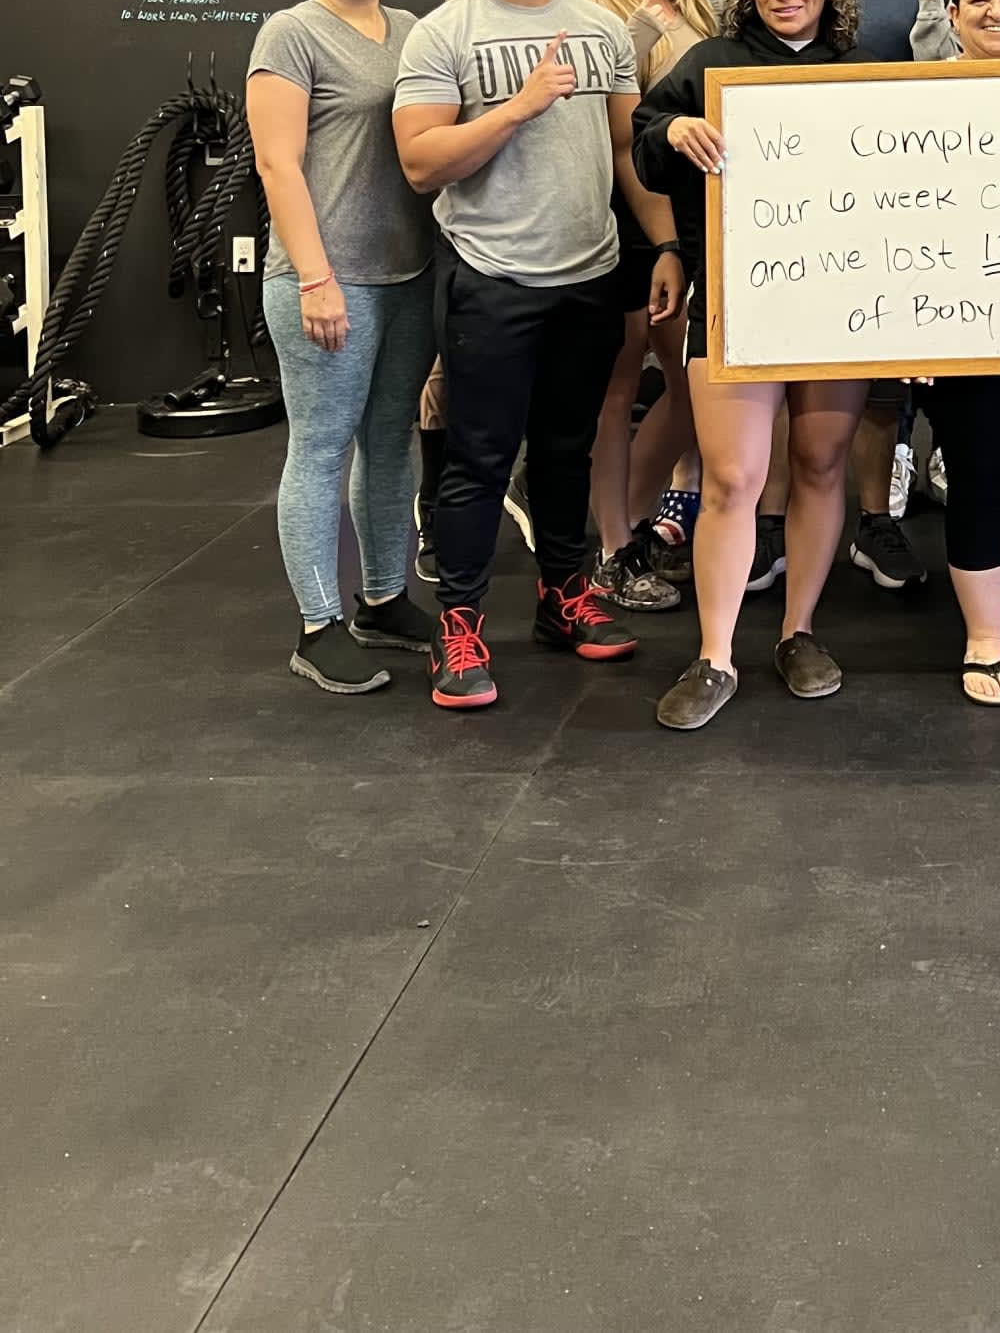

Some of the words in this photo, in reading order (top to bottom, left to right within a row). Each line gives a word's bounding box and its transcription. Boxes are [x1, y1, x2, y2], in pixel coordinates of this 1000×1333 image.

[137, 11, 165, 21] WORK
[753, 122, 804, 161] We
[830, 188, 855, 212] 6
[873, 187, 957, 210] week
[750, 256, 805, 287] and
[884, 236, 956, 273] lost
[848, 294, 892, 332] of
